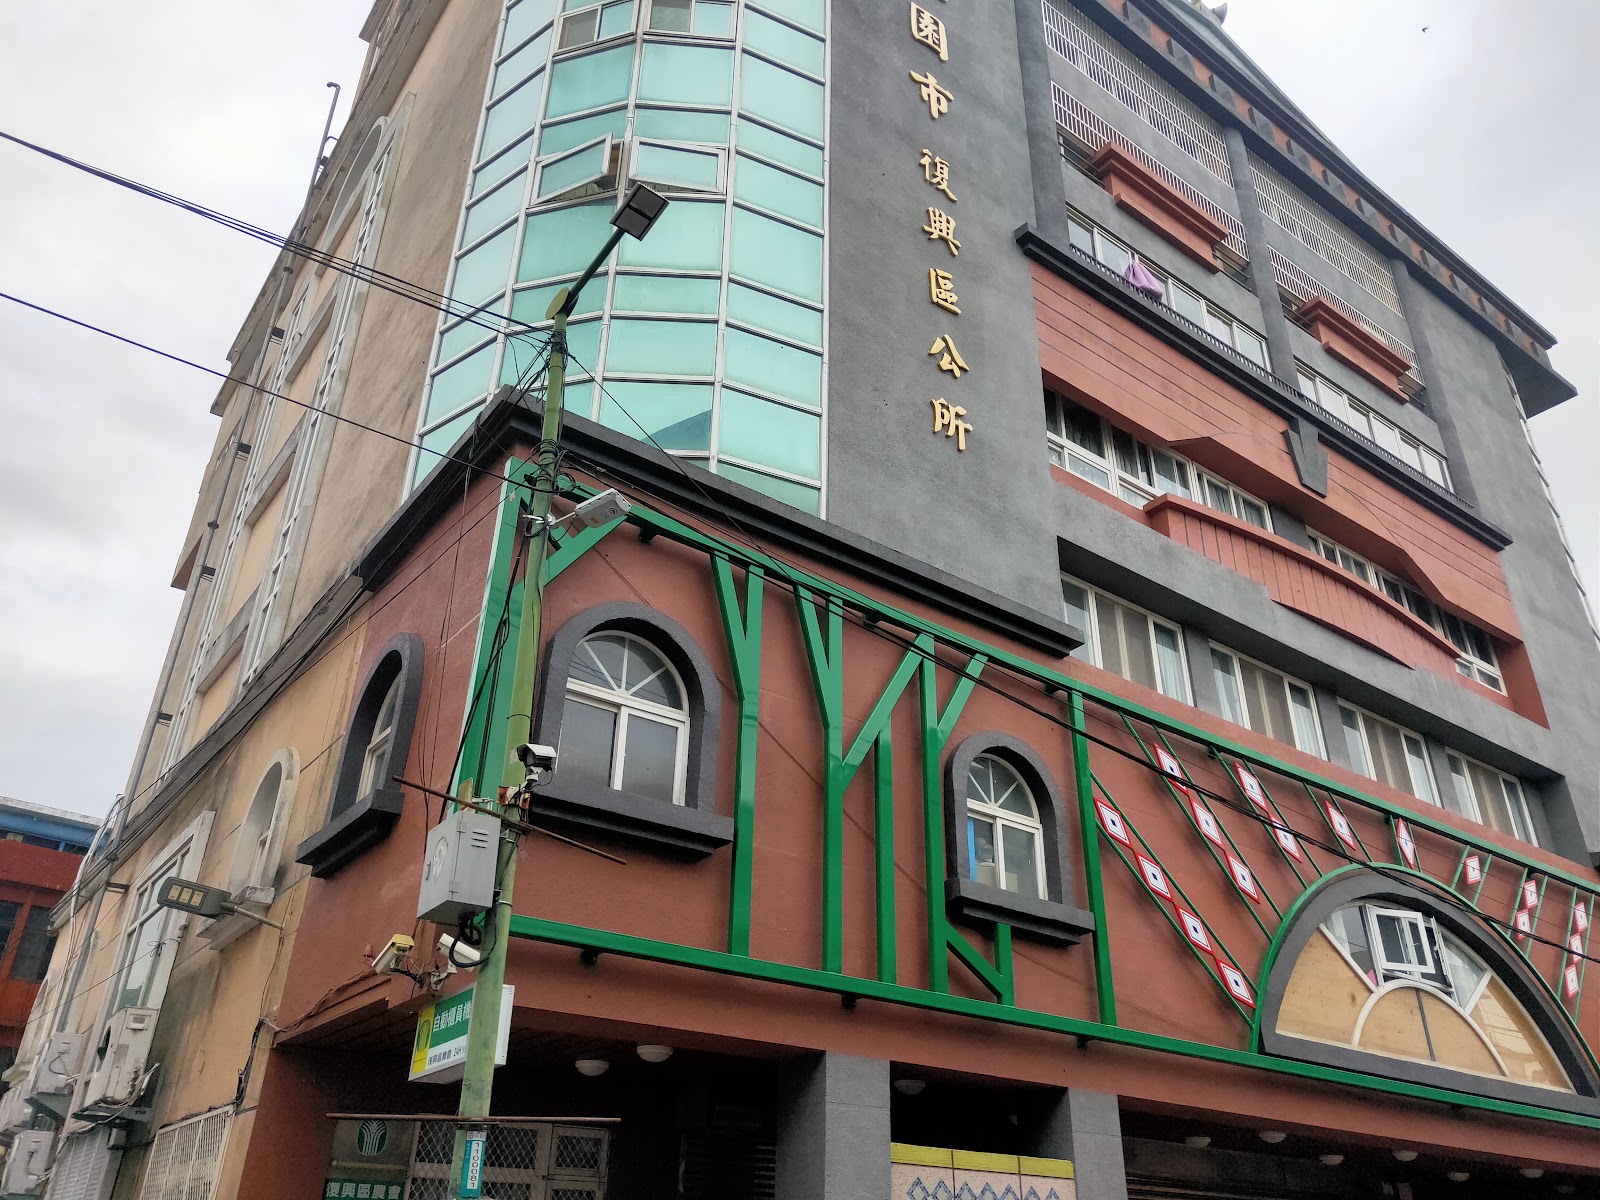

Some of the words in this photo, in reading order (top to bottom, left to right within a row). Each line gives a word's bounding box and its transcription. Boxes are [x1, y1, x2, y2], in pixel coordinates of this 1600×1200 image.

[908, 0, 974, 451] 園市復興區公所
[433, 1001, 472, 1033] 自動櫃員機
[325, 1181, 401, 1200] 復興區農會
